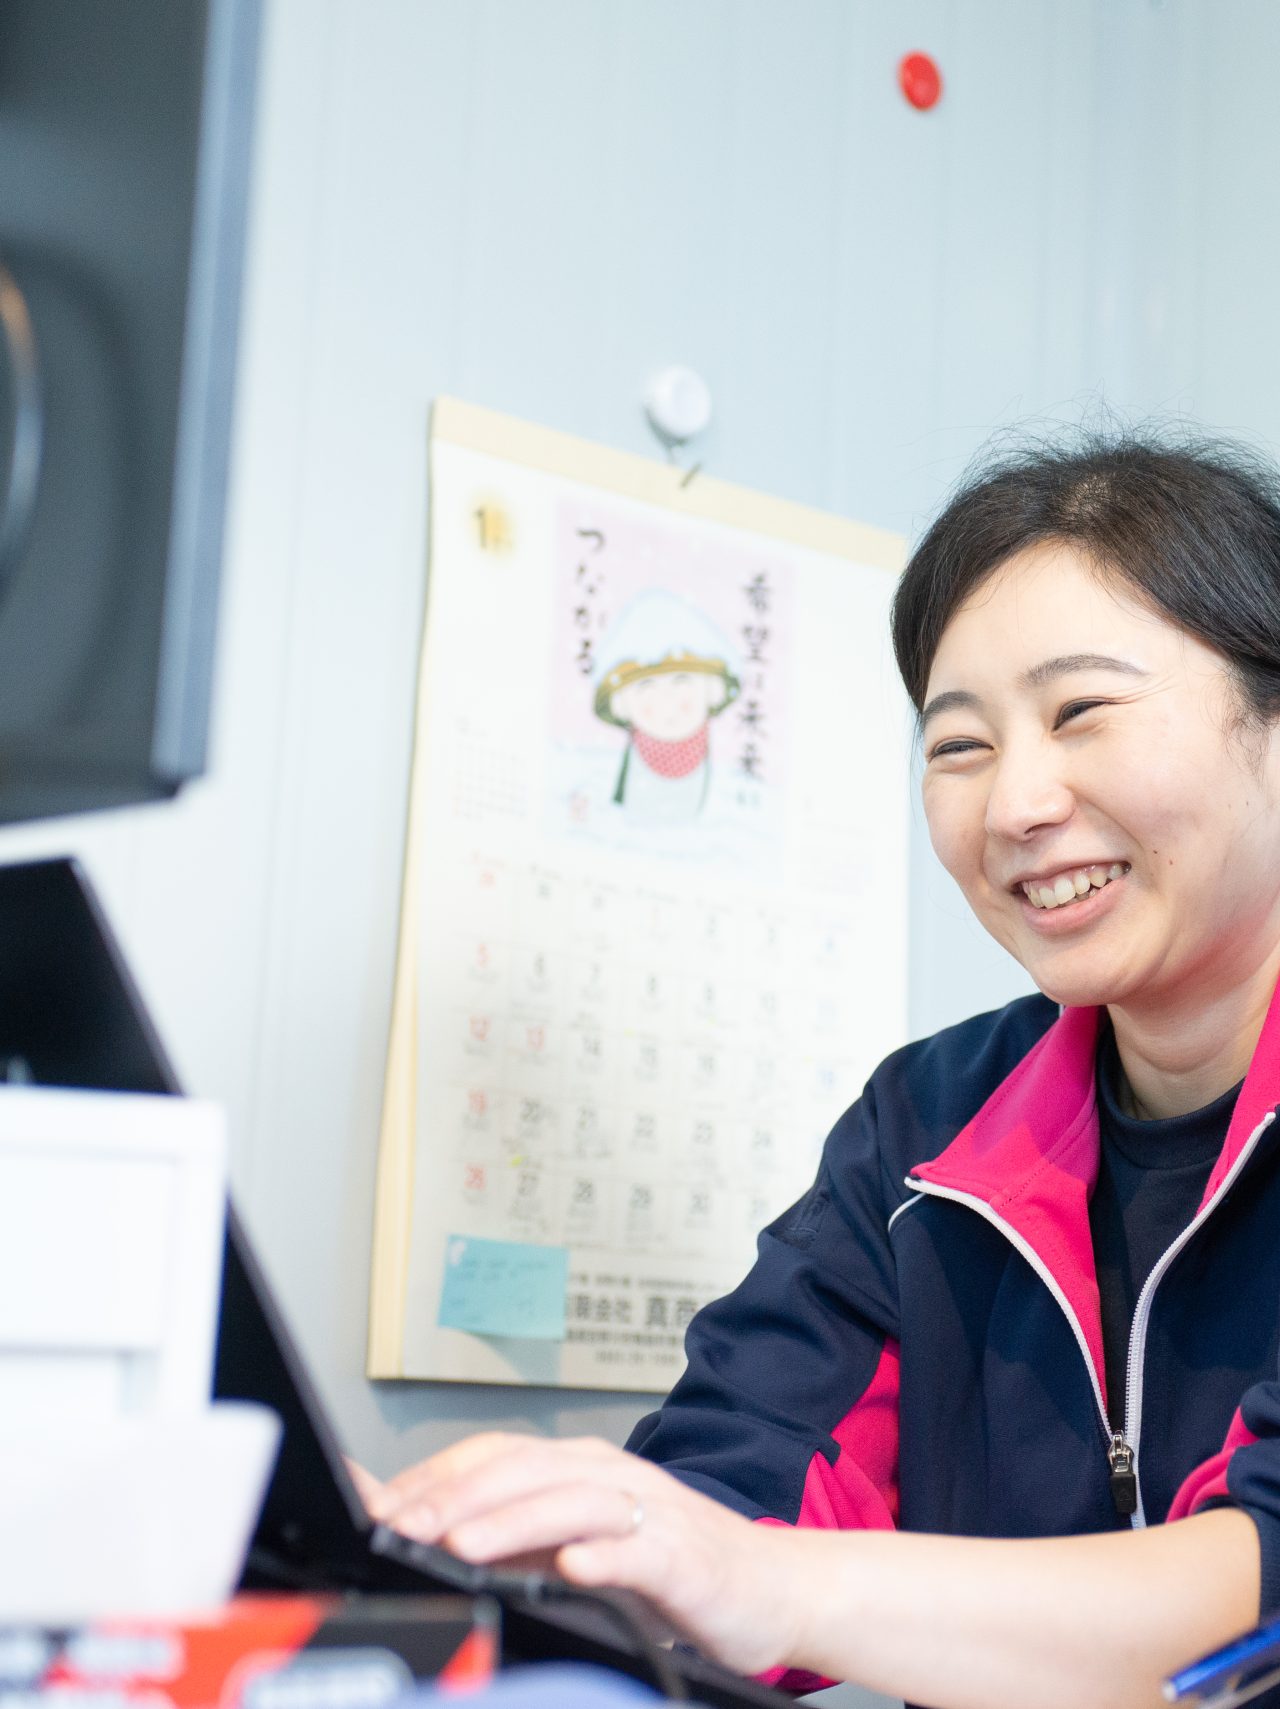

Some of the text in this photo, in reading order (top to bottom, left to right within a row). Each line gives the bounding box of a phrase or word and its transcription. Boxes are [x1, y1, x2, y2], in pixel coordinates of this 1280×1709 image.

[521, 1096, 543, 1124] 20
[566, 1294, 632, 1325] 限会社
